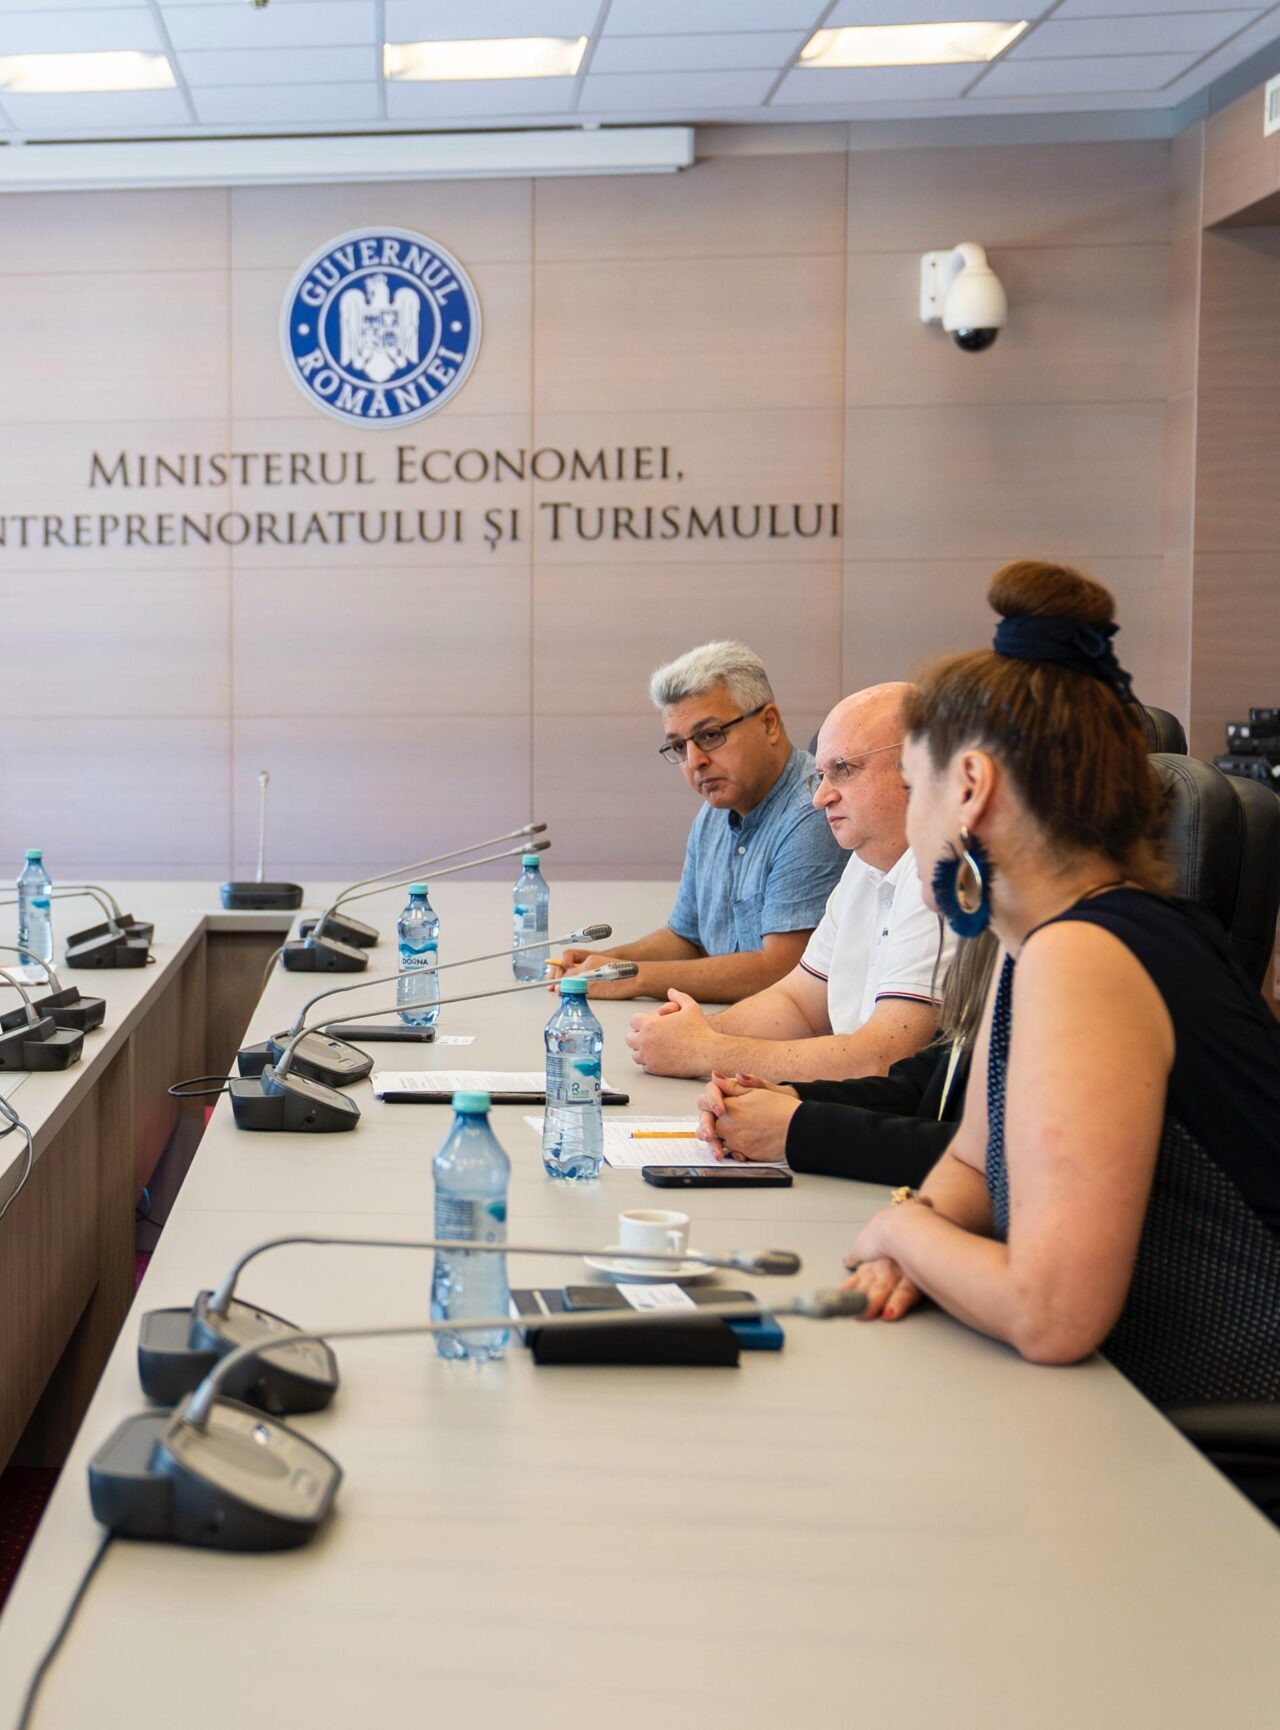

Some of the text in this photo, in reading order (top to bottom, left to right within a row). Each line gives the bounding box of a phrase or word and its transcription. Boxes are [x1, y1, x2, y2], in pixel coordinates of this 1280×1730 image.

[299, 239, 459, 306] GUVERNUL
[88, 445, 685, 488] MINISTERUL ECONOMIEI,
[540, 502, 842, 541] TURISMULUI
